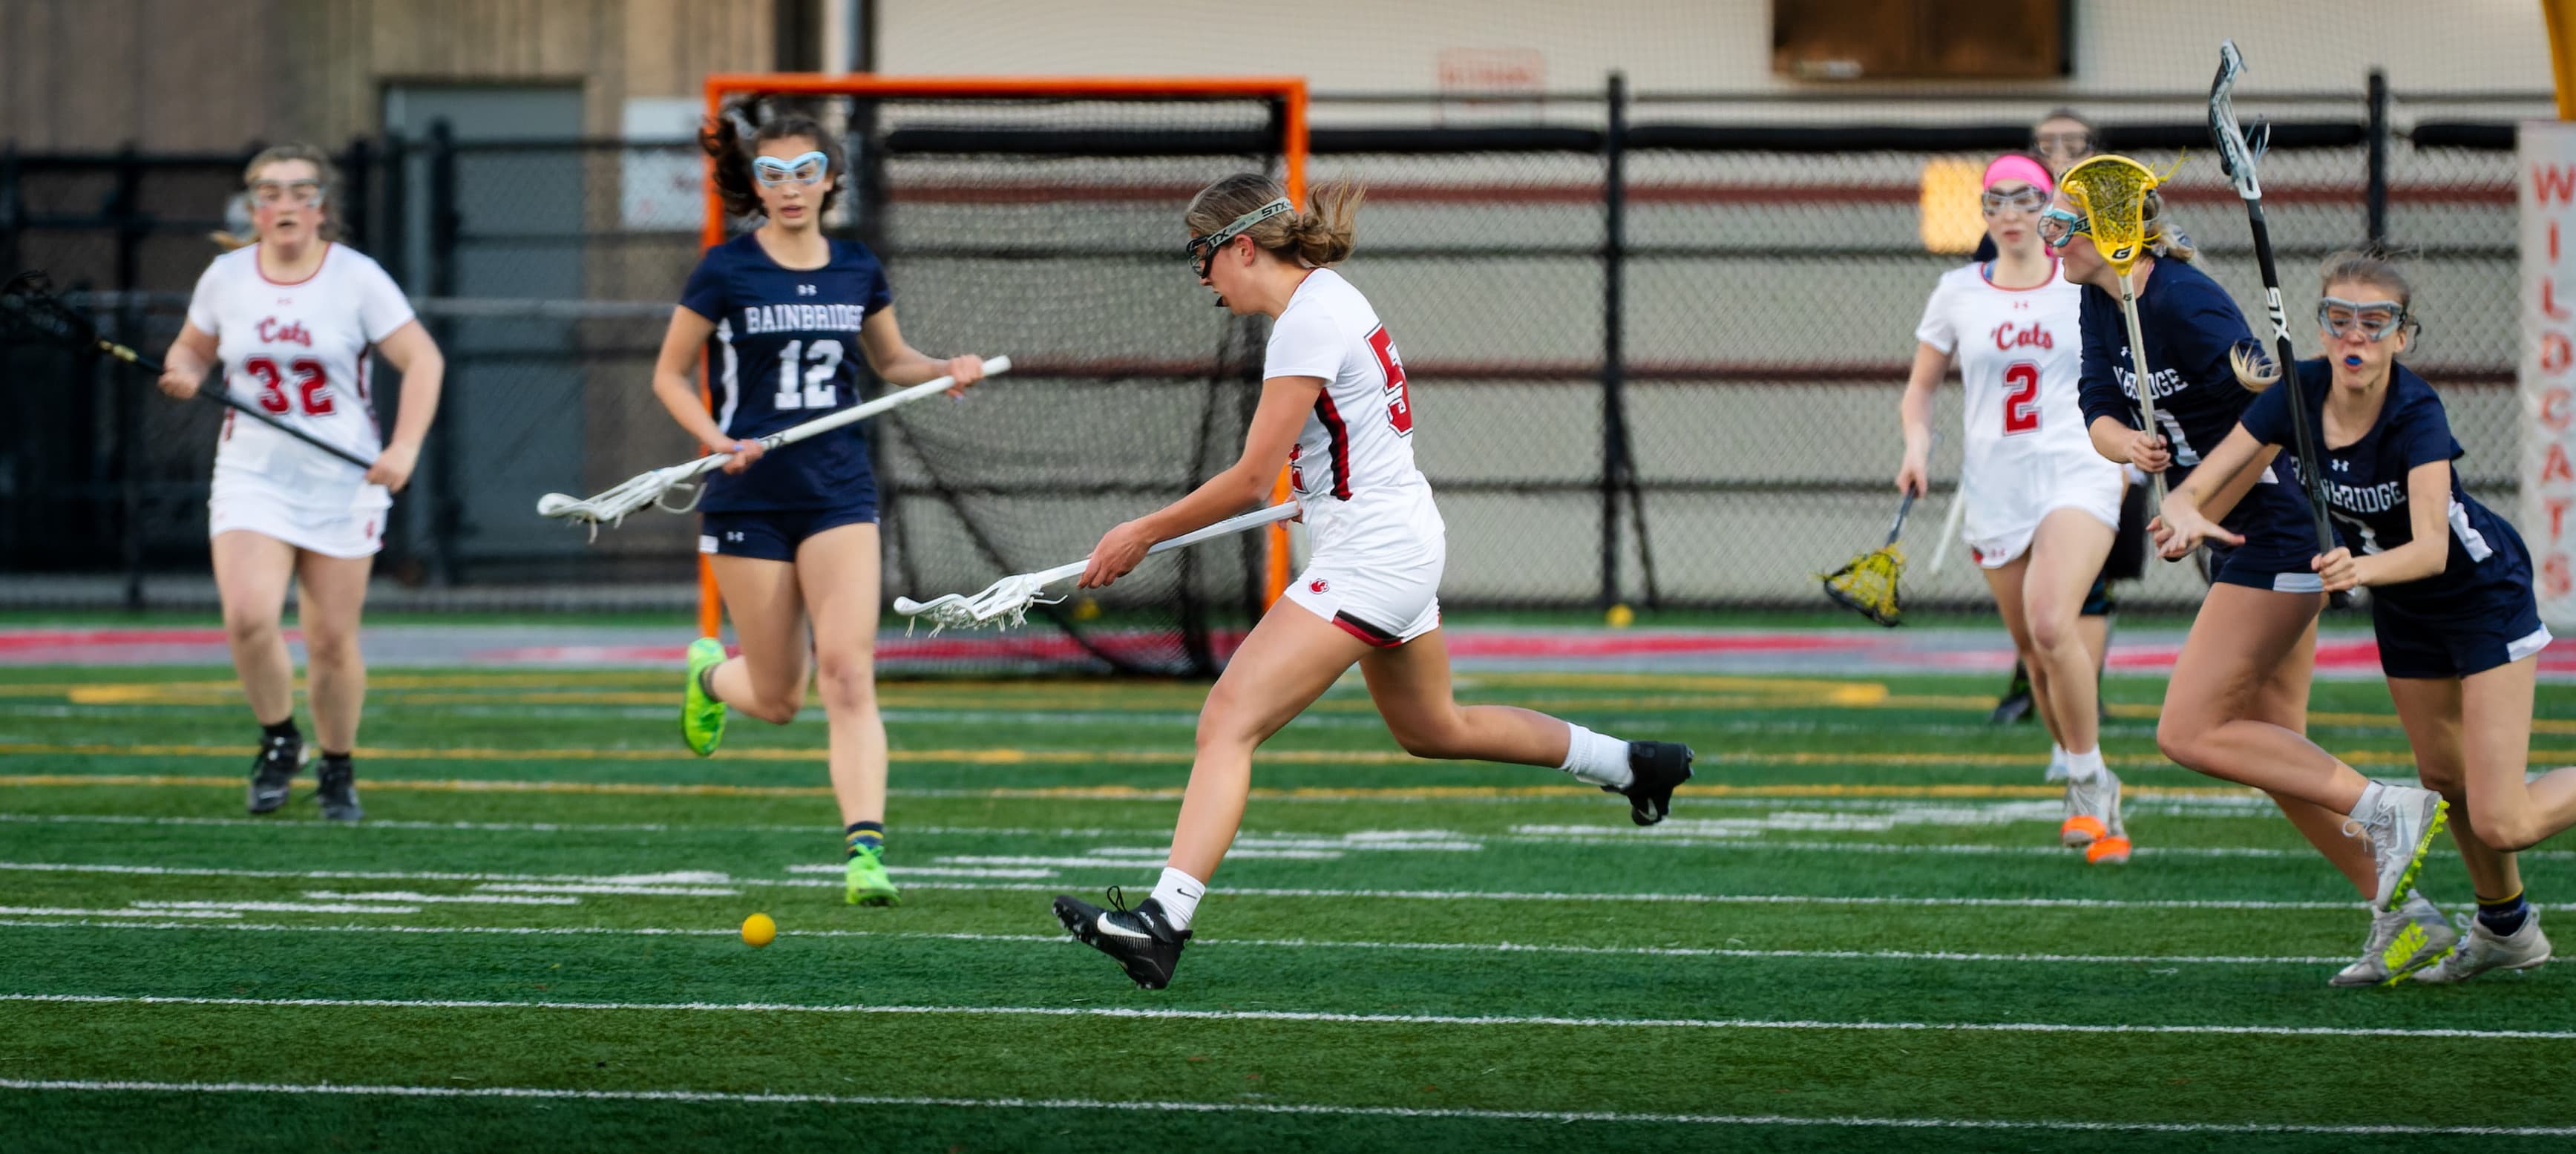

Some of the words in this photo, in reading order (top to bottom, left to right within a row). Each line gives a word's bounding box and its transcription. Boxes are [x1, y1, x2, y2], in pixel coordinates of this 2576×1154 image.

[1262, 201, 1288, 217] STX
[744, 304, 865, 334] BAINBRIDGE
[2266, 286, 2291, 341] STX
[244, 353, 336, 417] 32
[775, 338, 845, 410] 12
[2002, 358, 2043, 436] 2
[2531, 161, 2576, 600] WILDCATS
